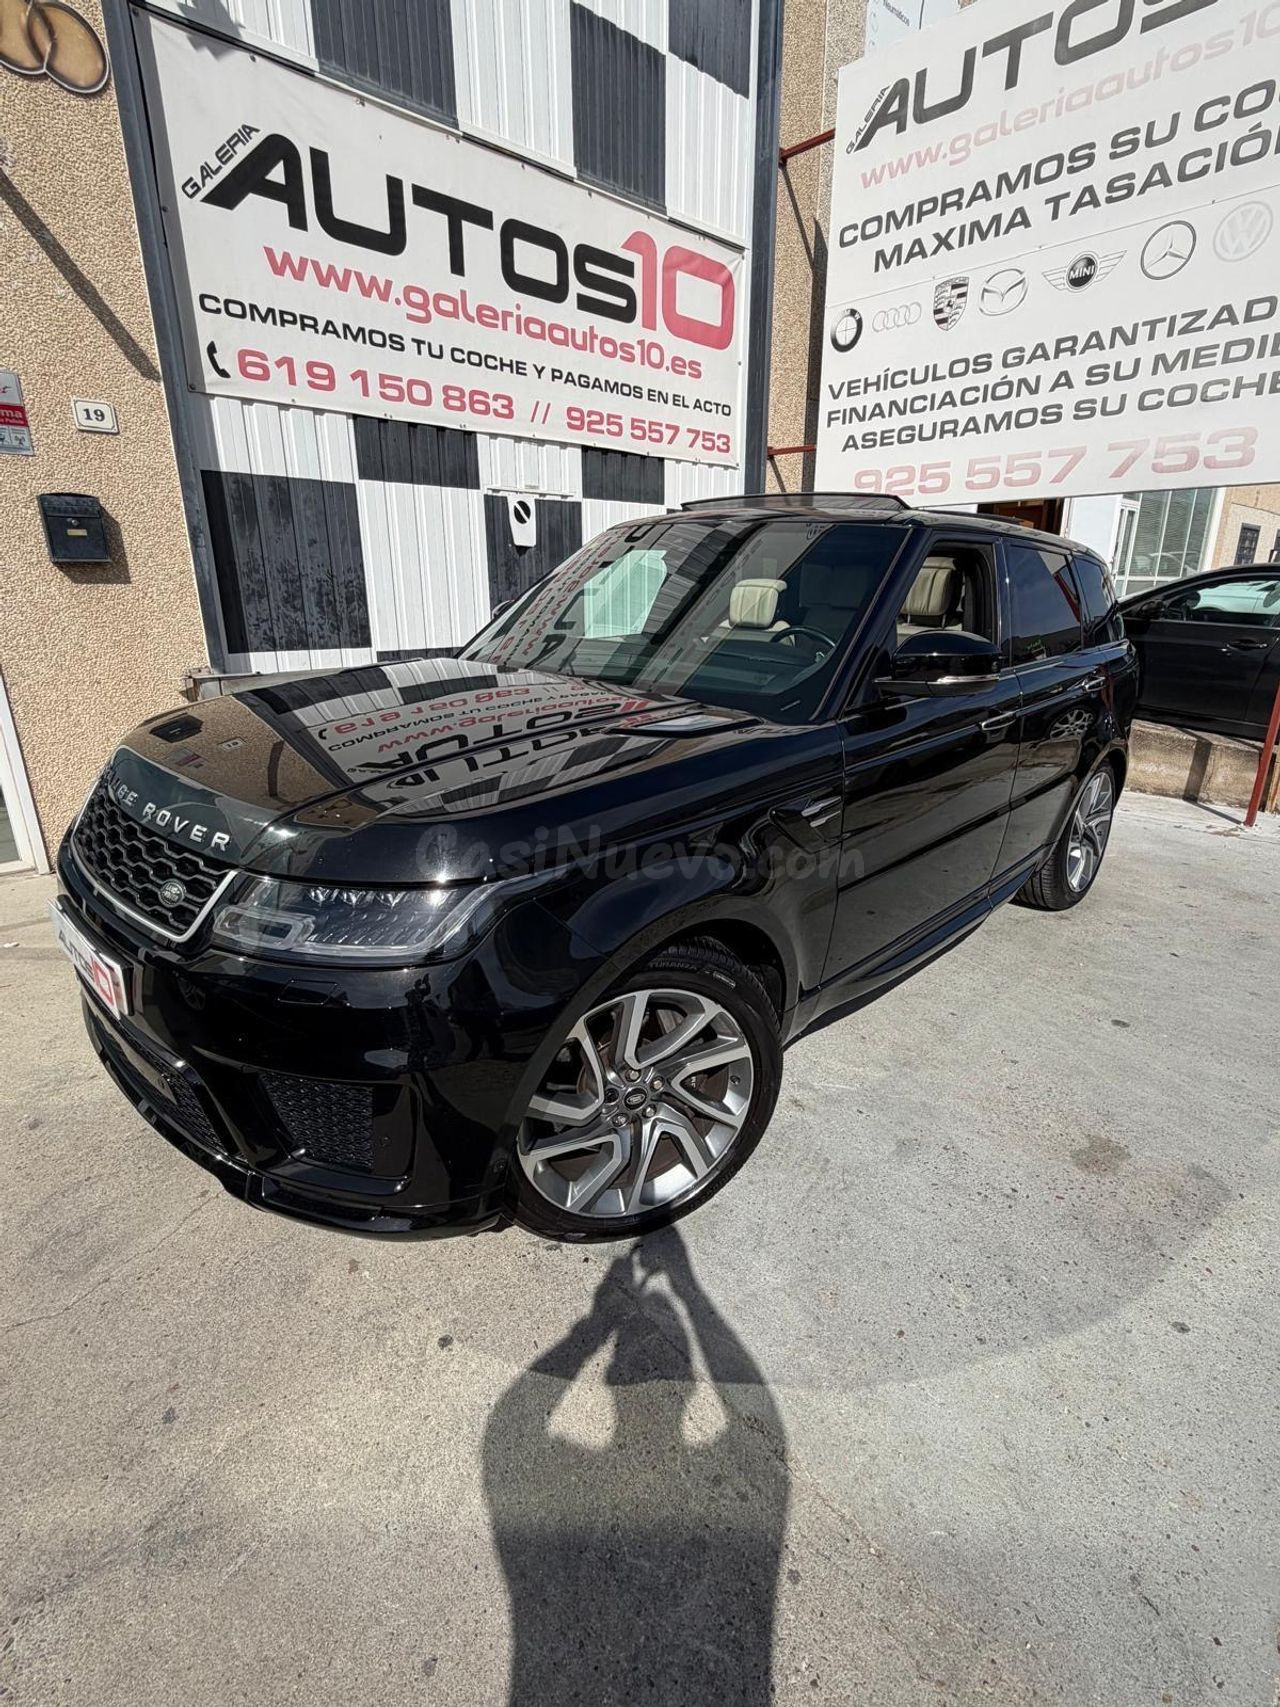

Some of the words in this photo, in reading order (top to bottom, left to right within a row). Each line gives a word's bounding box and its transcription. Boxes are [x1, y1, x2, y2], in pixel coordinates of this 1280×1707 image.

[846, 86, 890, 154] GALERIA
[181, 124, 261, 199] GALERIA
[839, 142, 1097, 249] COMPRAMOS
[1109, 112, 1181, 160] SU
[1194, 79, 1280, 132] CO
[874, 206, 1031, 273] MAXIMA
[1045, 121, 1280, 222] TASACIÓ
[1069, 264, 1095, 280] MINI
[263, 246, 702, 378] www.galeriaautos10.es
[199, 294, 405, 352] COMPRAMOS
[411, 338, 444, 359] TU
[451, 347, 527, 376] COCHE
[533, 364, 546, 379] Y
[551, 369, 644, 399] PAGAMOS
[648, 389, 669, 404] EN
[672, 394, 688, 409] EL
[693, 398, 732, 416] ACTO
[829, 352, 993, 399] VEHÍCULOS
[83, 408, 105, 422] 19
[237, 348, 336, 392] 619
[350, 369, 433, 407] 150
[442, 385, 514, 420] 863
[566, 406, 624, 437] 925
[630, 417, 680, 445] 557
[686, 428, 731, 454] 753
[827, 374, 1041, 428] FINANCIACIÓN
[1049, 369, 1075, 392] A
[1085, 357, 1141, 387] SU
[842, 403, 1063, 452] ASEGURAMOS
[1073, 394, 1126, 421] SU
[853, 460, 951, 496] 925
[964, 446, 1088, 491] 557
[1107, 426, 1259, 480] 753
[142, 802, 230, 852] ROVER
